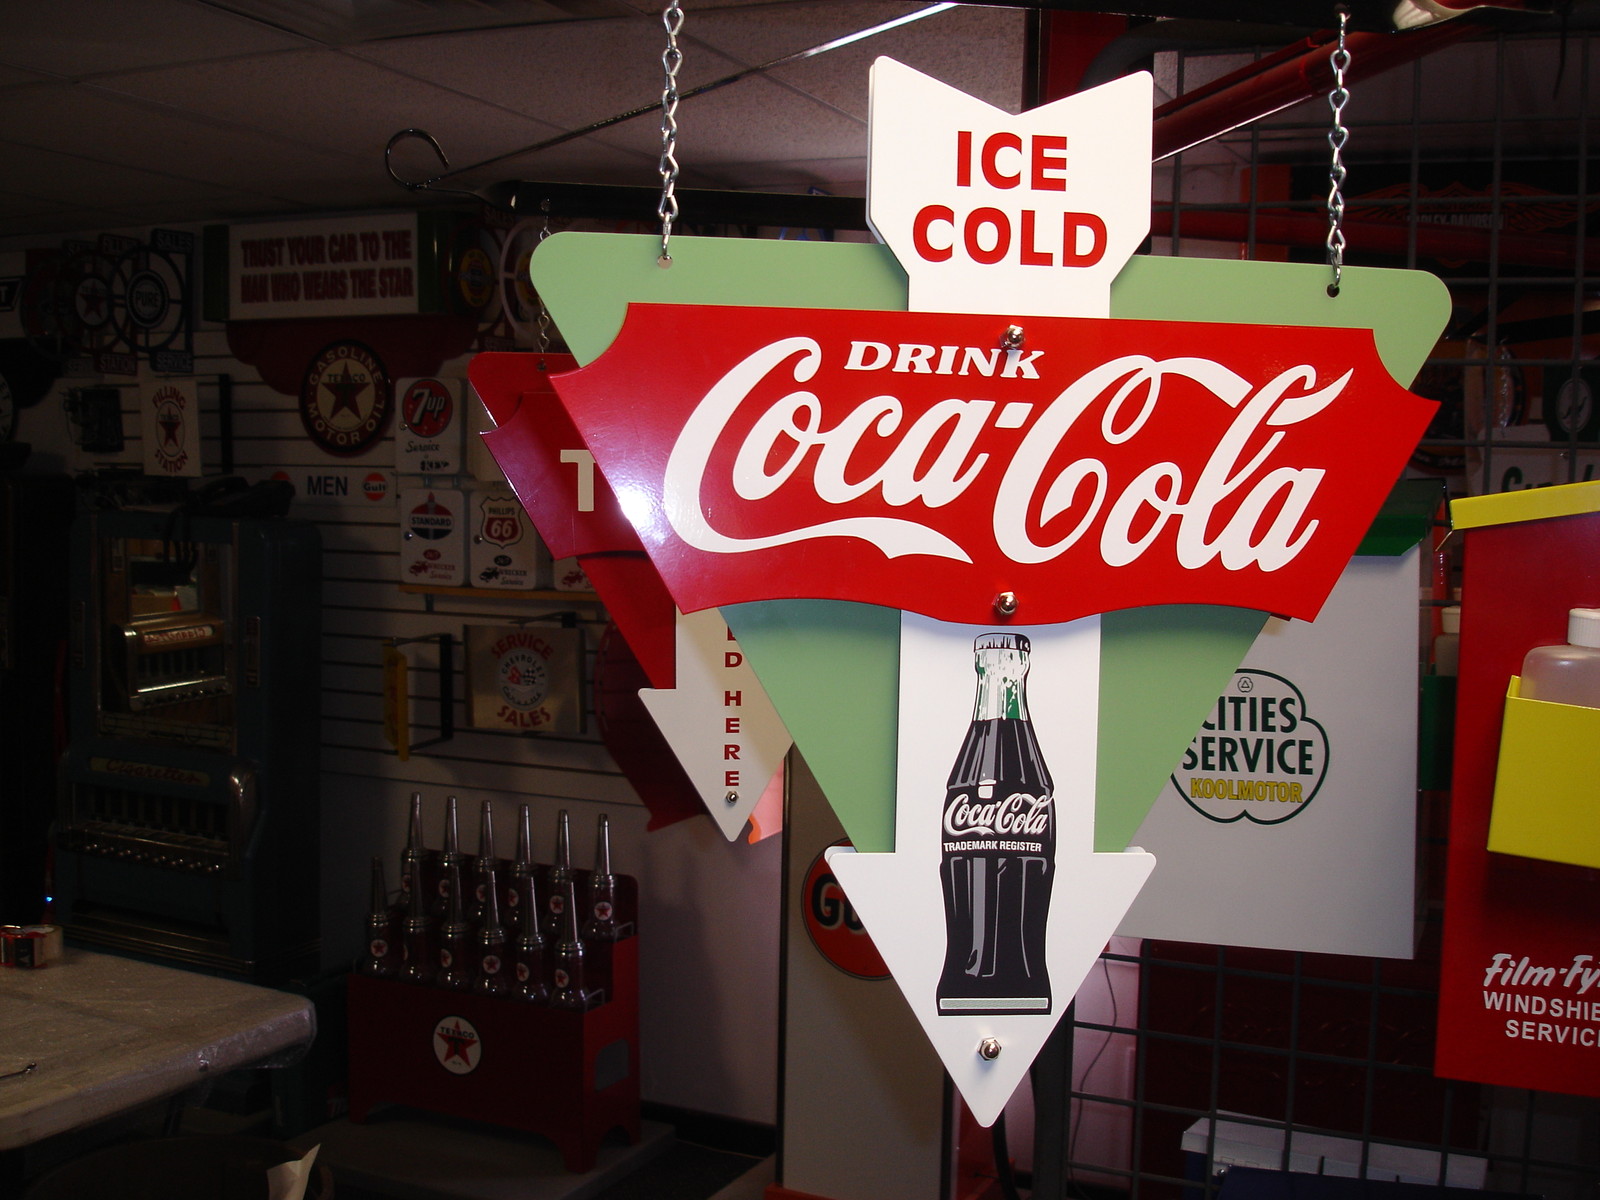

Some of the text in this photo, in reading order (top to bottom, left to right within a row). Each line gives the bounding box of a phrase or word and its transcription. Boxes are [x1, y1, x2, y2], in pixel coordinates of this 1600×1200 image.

[957, 131, 1067, 192] ICE
[241, 230, 412, 268] TRUST YOUR CAR TO THE
[913, 204, 1107, 268] COLD
[241, 267, 414, 304] MAN WHO WEARS THE STAR
[309, 346, 383, 385] GASOLINE
[845, 341, 1044, 380] DRINK
[307, 400, 385, 445] MOTOR OIL
[154, 449, 188, 473] STATION
[664, 336, 1354, 571] Coca-Cola
[307, 475, 348, 497] MEN
[363, 482, 386, 492] Gulf
[411, 516, 451, 527] STANDARD
[489, 507, 515, 517] PHILLIPS
[490, 519, 514, 537] 66
[491, 633, 553, 660] SERVICE
[497, 705, 550, 728] SALES
[724, 690, 742, 787] HERE
[1182, 737, 1313, 775] SERVICE
[1190, 777, 1303, 803] KOOLMOTOR
[944, 793, 1054, 836] Coca-Cola
[944, 841, 1042, 852] TRADEMARK REGISTER
[1483, 953, 1600, 994] Film-Fy
[1505, 1019, 1600, 1047] SERVIC
